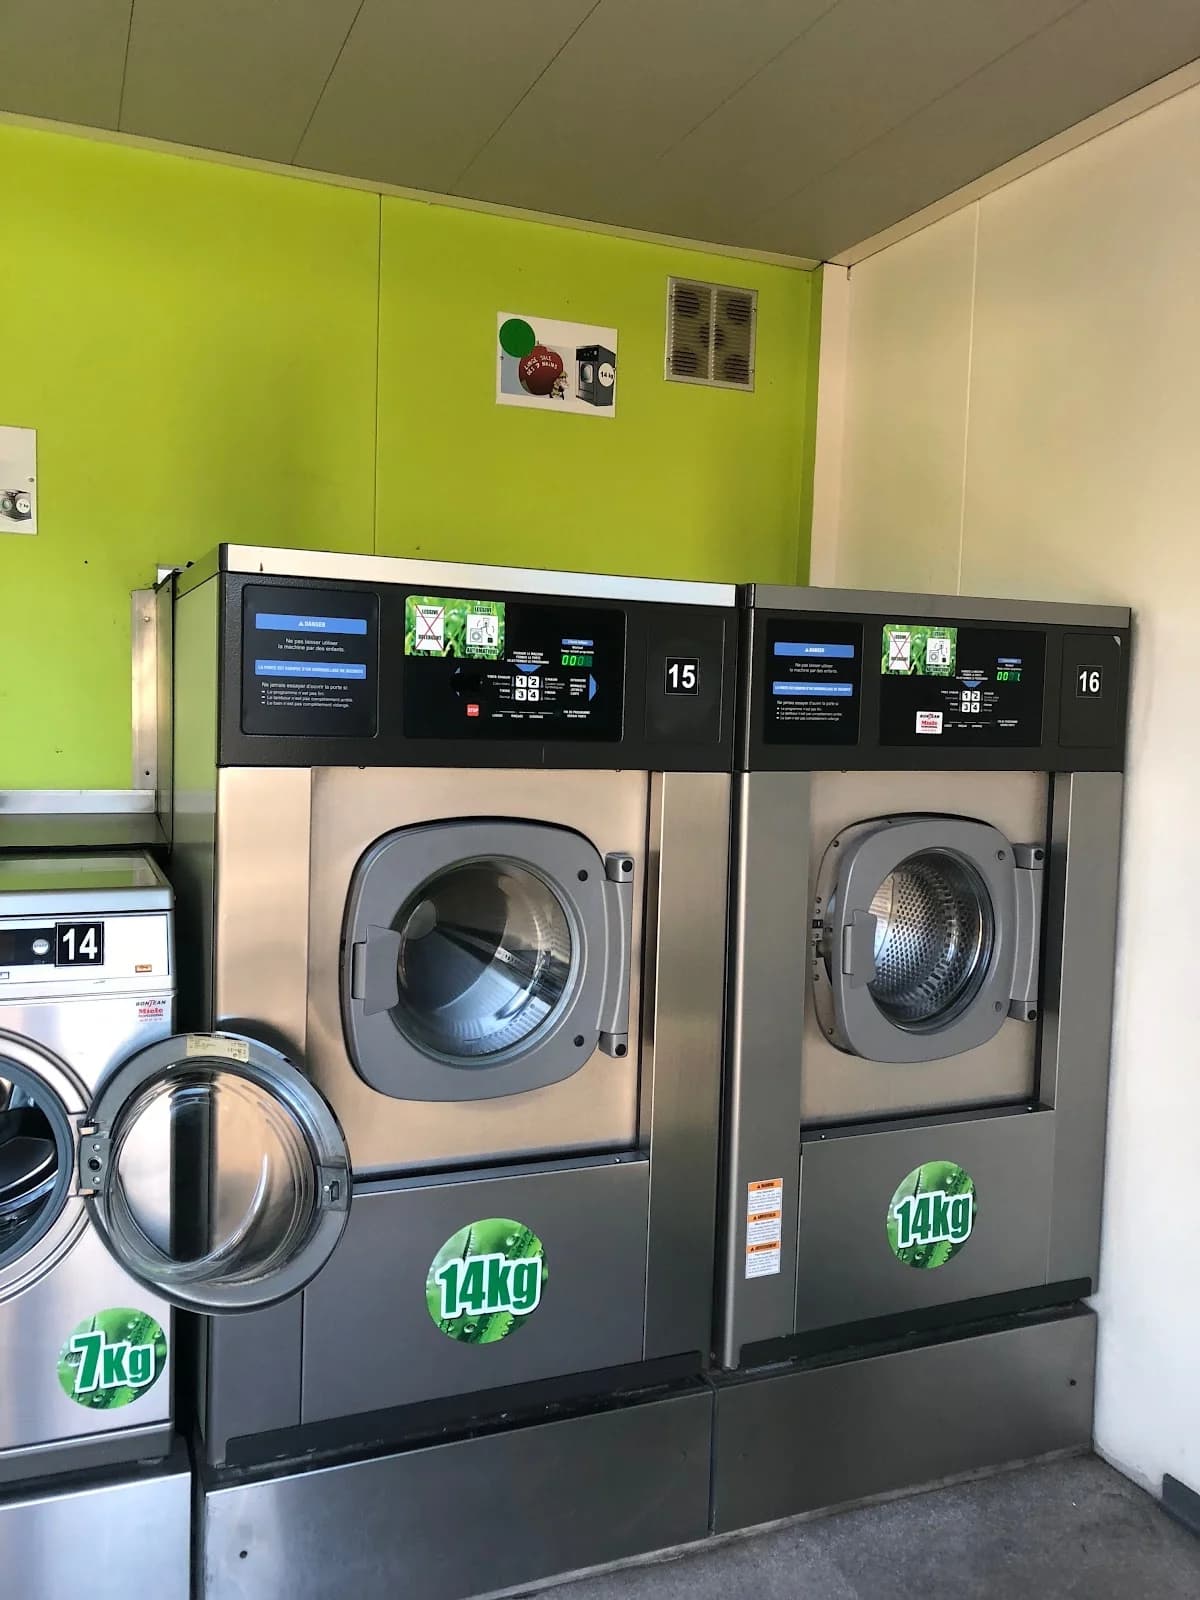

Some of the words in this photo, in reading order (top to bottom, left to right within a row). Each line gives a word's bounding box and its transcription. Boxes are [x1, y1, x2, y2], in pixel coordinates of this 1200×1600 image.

[668, 664, 696, 688] 15
[1080, 670, 1100, 692] 16
[62, 928, 98, 960] 14
[895, 1193, 971, 1245] 14kg
[437, 1255, 540, 1316] 14kg
